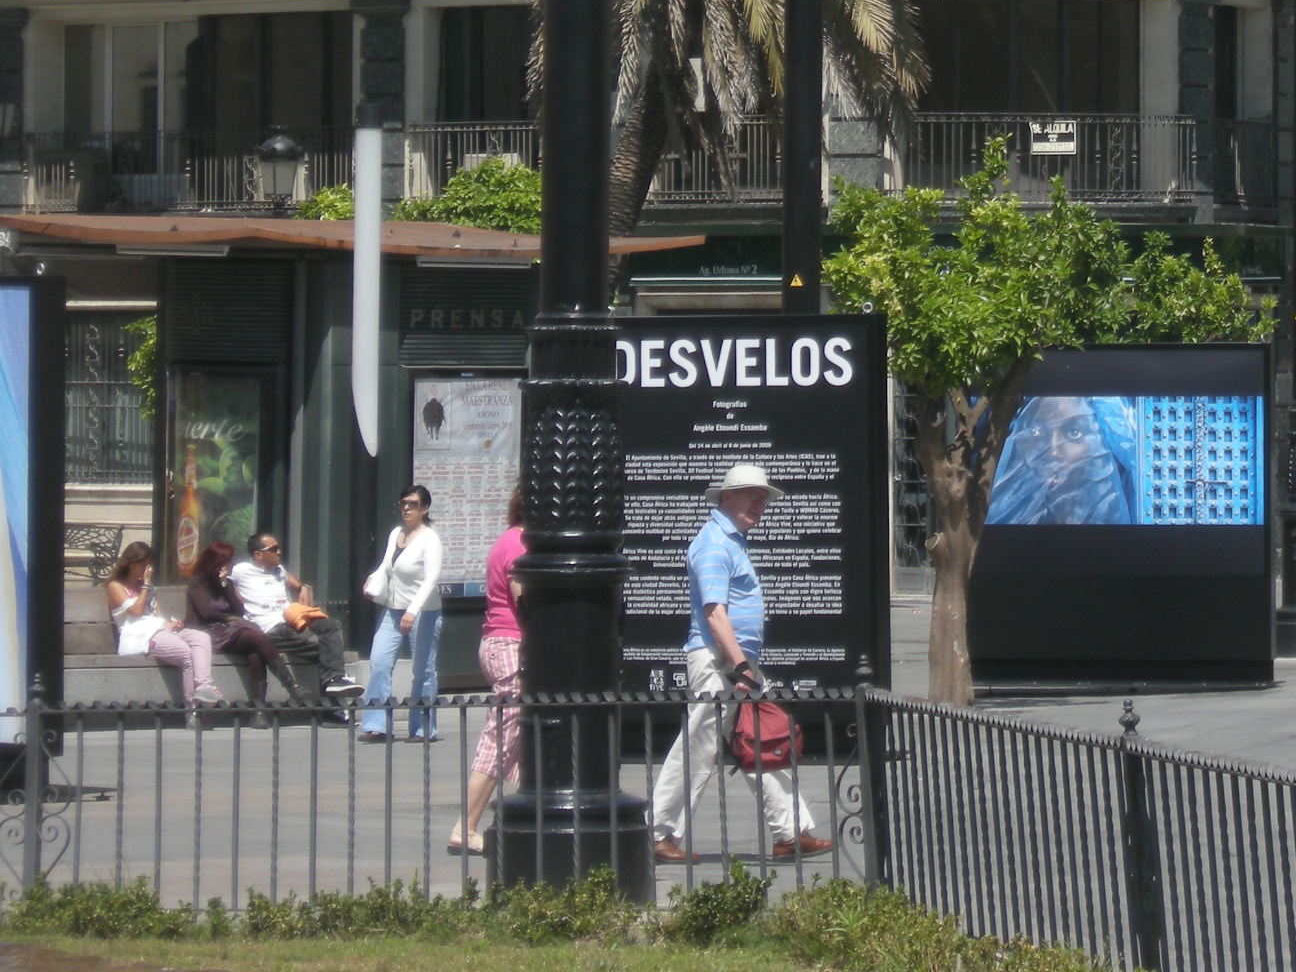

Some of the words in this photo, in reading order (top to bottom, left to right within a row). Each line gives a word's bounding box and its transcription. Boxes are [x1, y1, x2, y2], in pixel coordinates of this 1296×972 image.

[1032, 124, 1042, 134] SE
[1044, 123, 1073, 134] ALQUILA
[752, 264, 757, 274] 2
[410, 308, 524, 329] PRENSA
[616, 338, 852, 388] DESVELOS
[741, 424, 767, 432] Essamba
